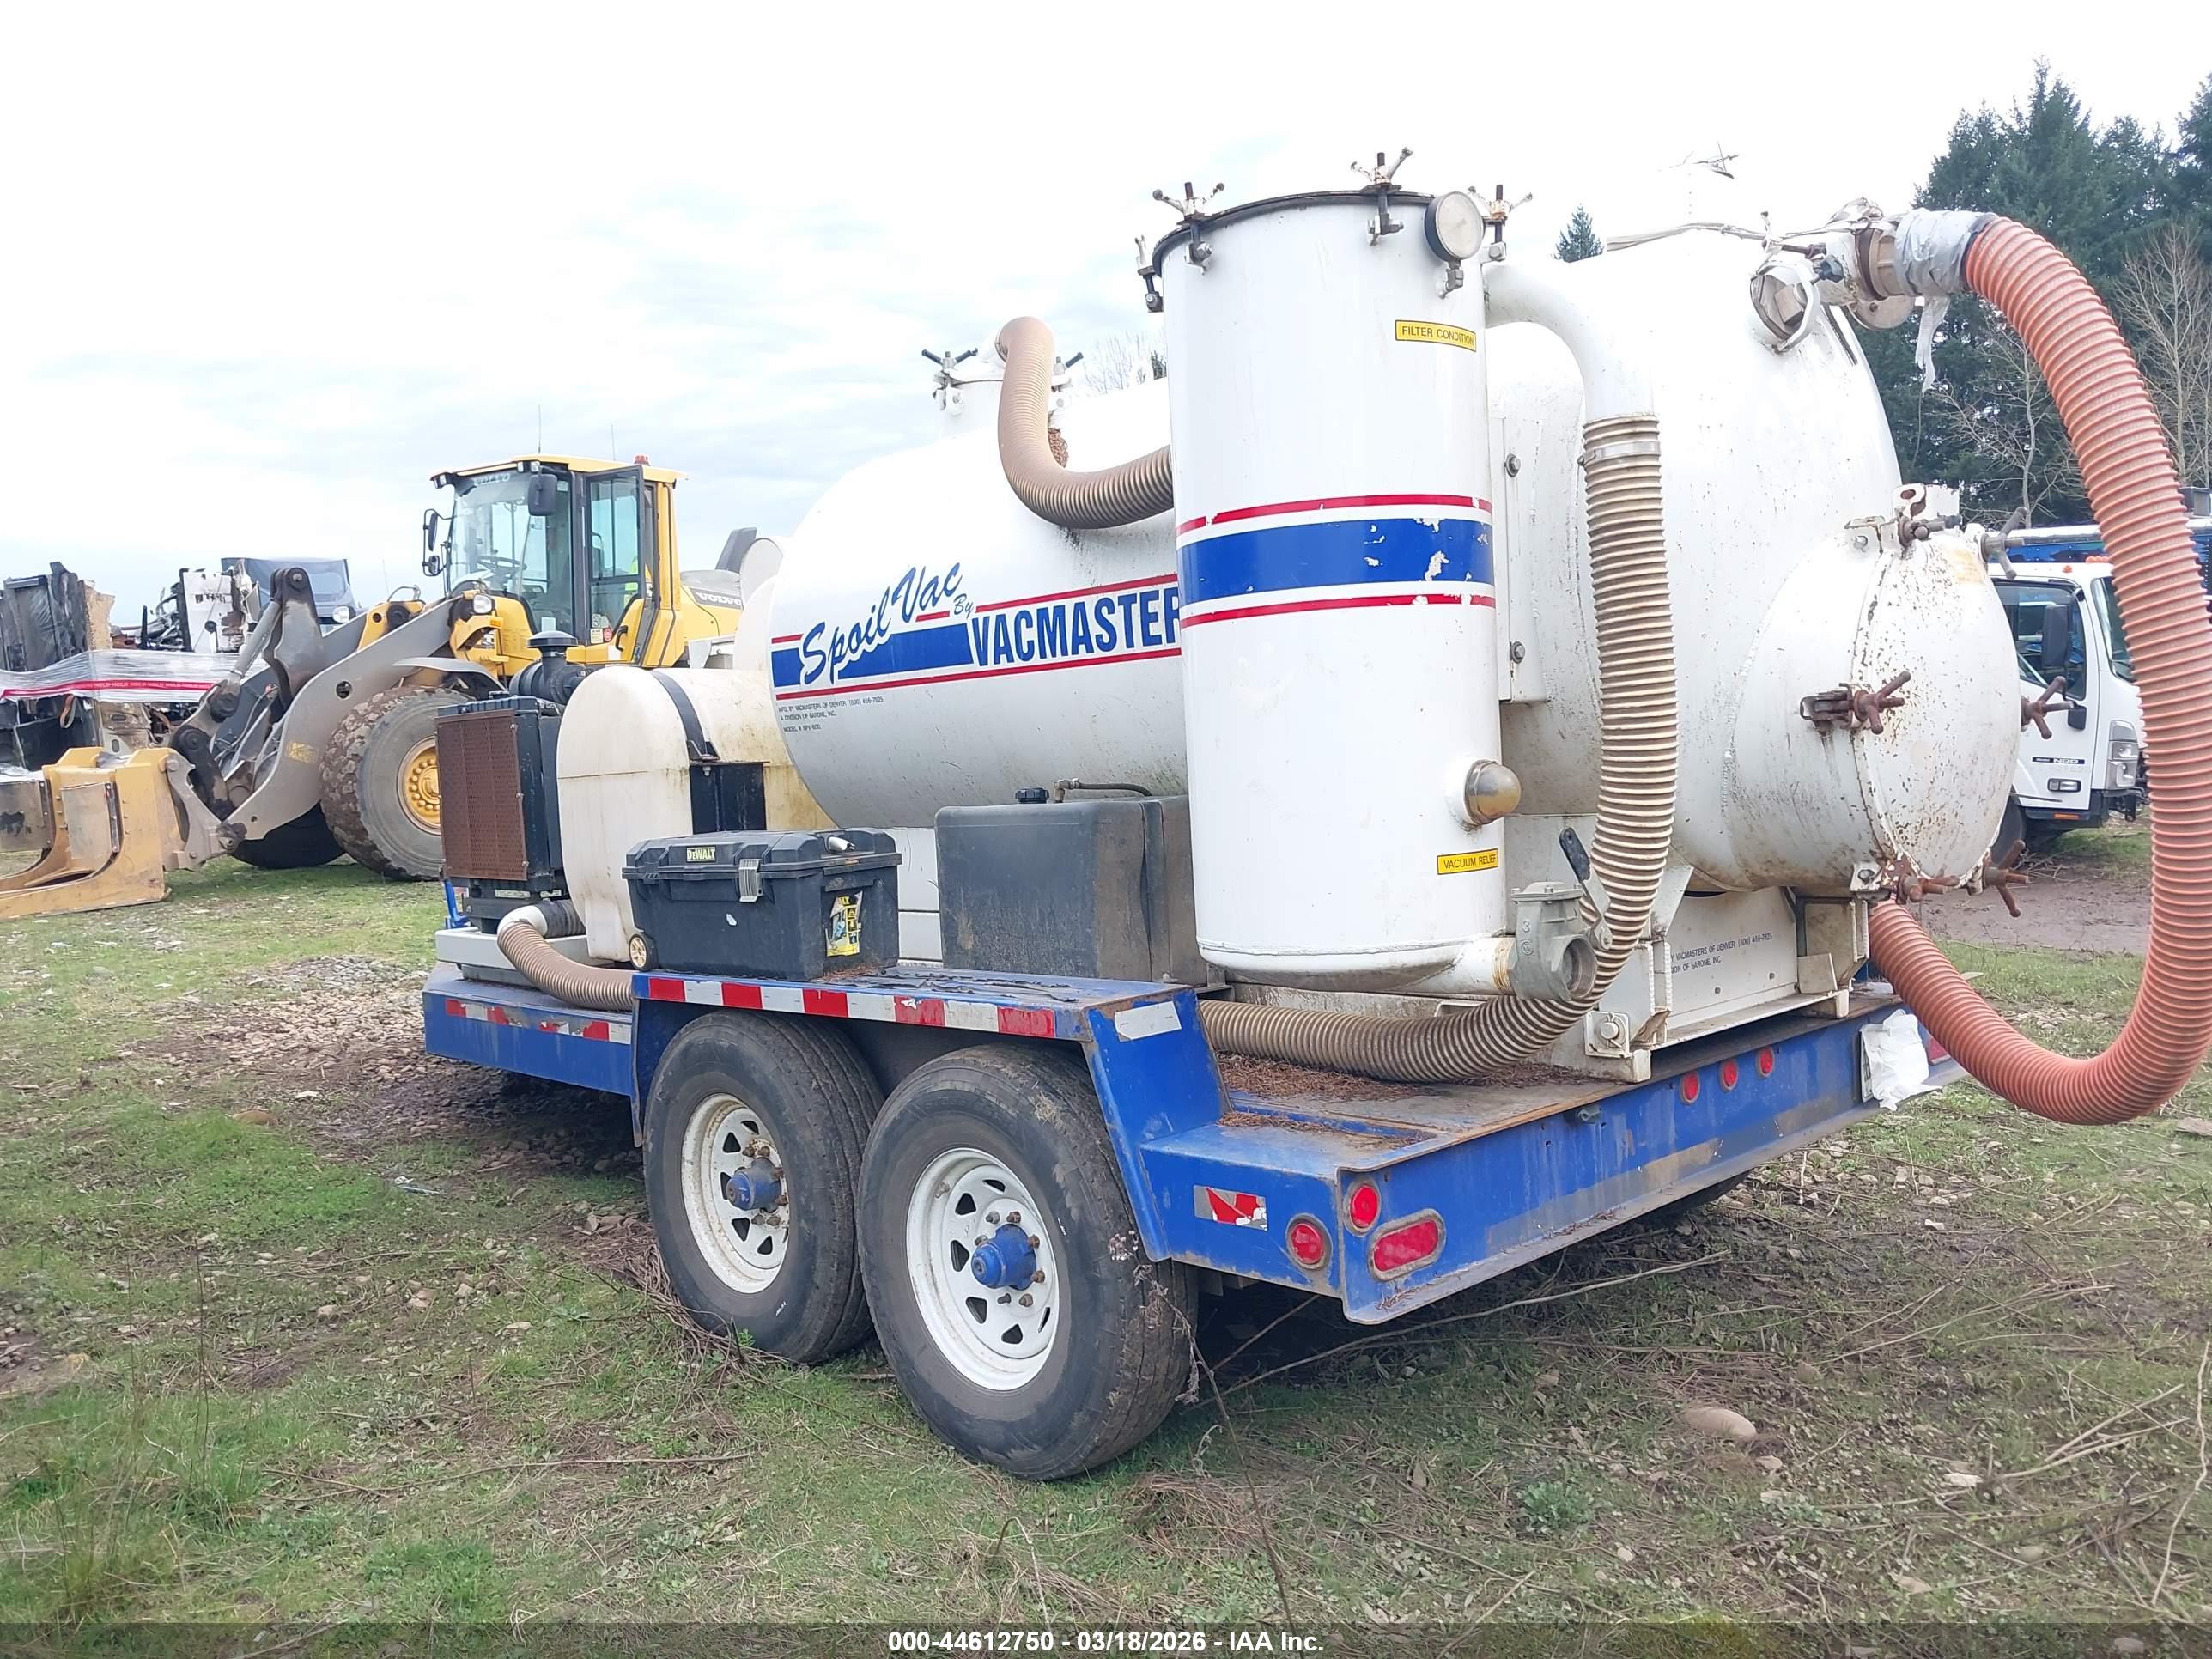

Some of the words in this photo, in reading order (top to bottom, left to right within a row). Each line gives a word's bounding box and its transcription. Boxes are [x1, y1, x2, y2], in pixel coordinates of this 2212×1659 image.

[1401, 325, 1433, 337] FILTER
[1437, 329, 1474, 345] CONDITION
[695, 592, 742, 606] VOLVO
[953, 593, 974, 618] By
[803, 586, 892, 684] Spoil
[891, 562, 963, 623] Vac
[972, 587, 1180, 666] VACMASTER
[1443, 857, 1476, 869] VACUUM
[1676, 946, 1707, 961] VACMASTERS
[1709, 945, 1716, 953] OF
[1717, 940, 1735, 951] DENVER
[1682, 963, 1690, 971] OF
